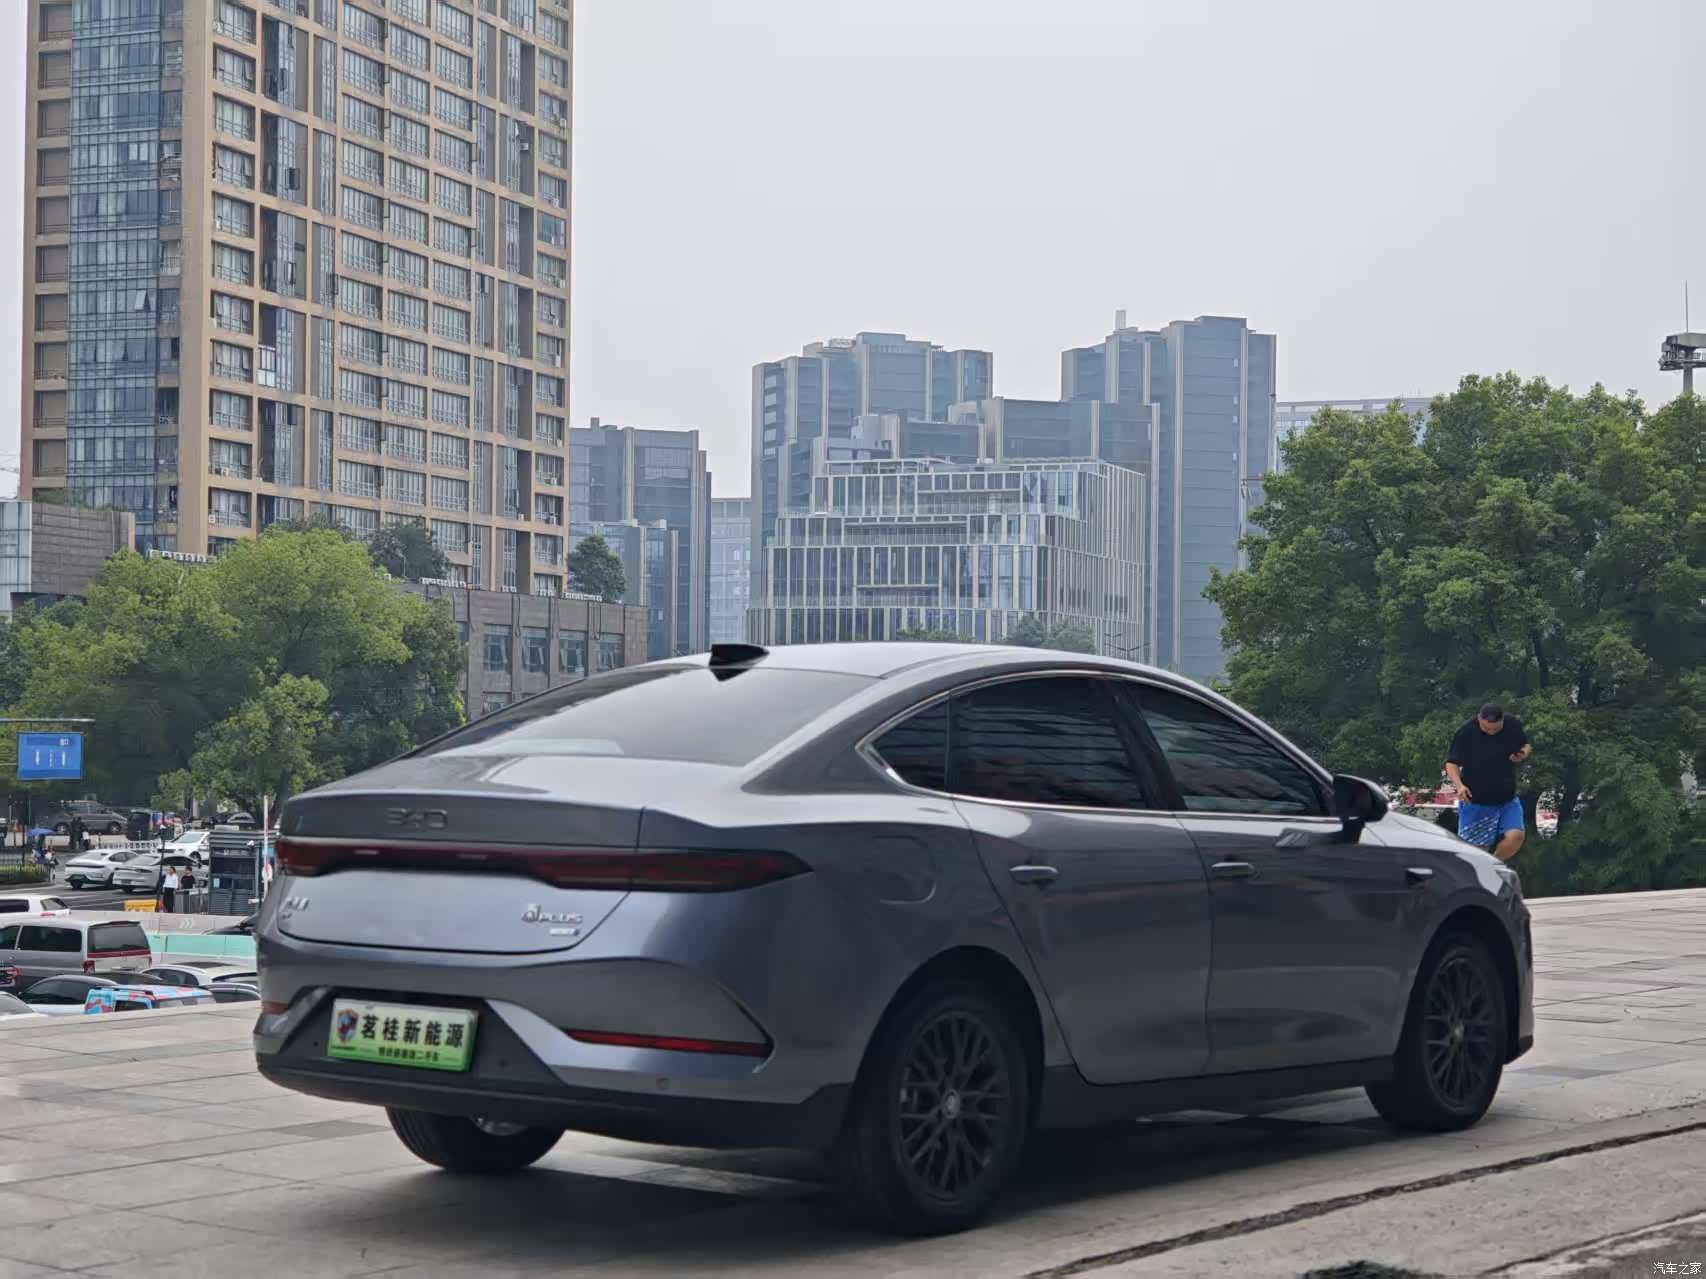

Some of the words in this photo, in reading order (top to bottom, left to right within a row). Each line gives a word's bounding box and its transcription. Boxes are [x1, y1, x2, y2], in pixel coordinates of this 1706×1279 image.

[360, 1013, 465, 1048] 茗桂新能源
